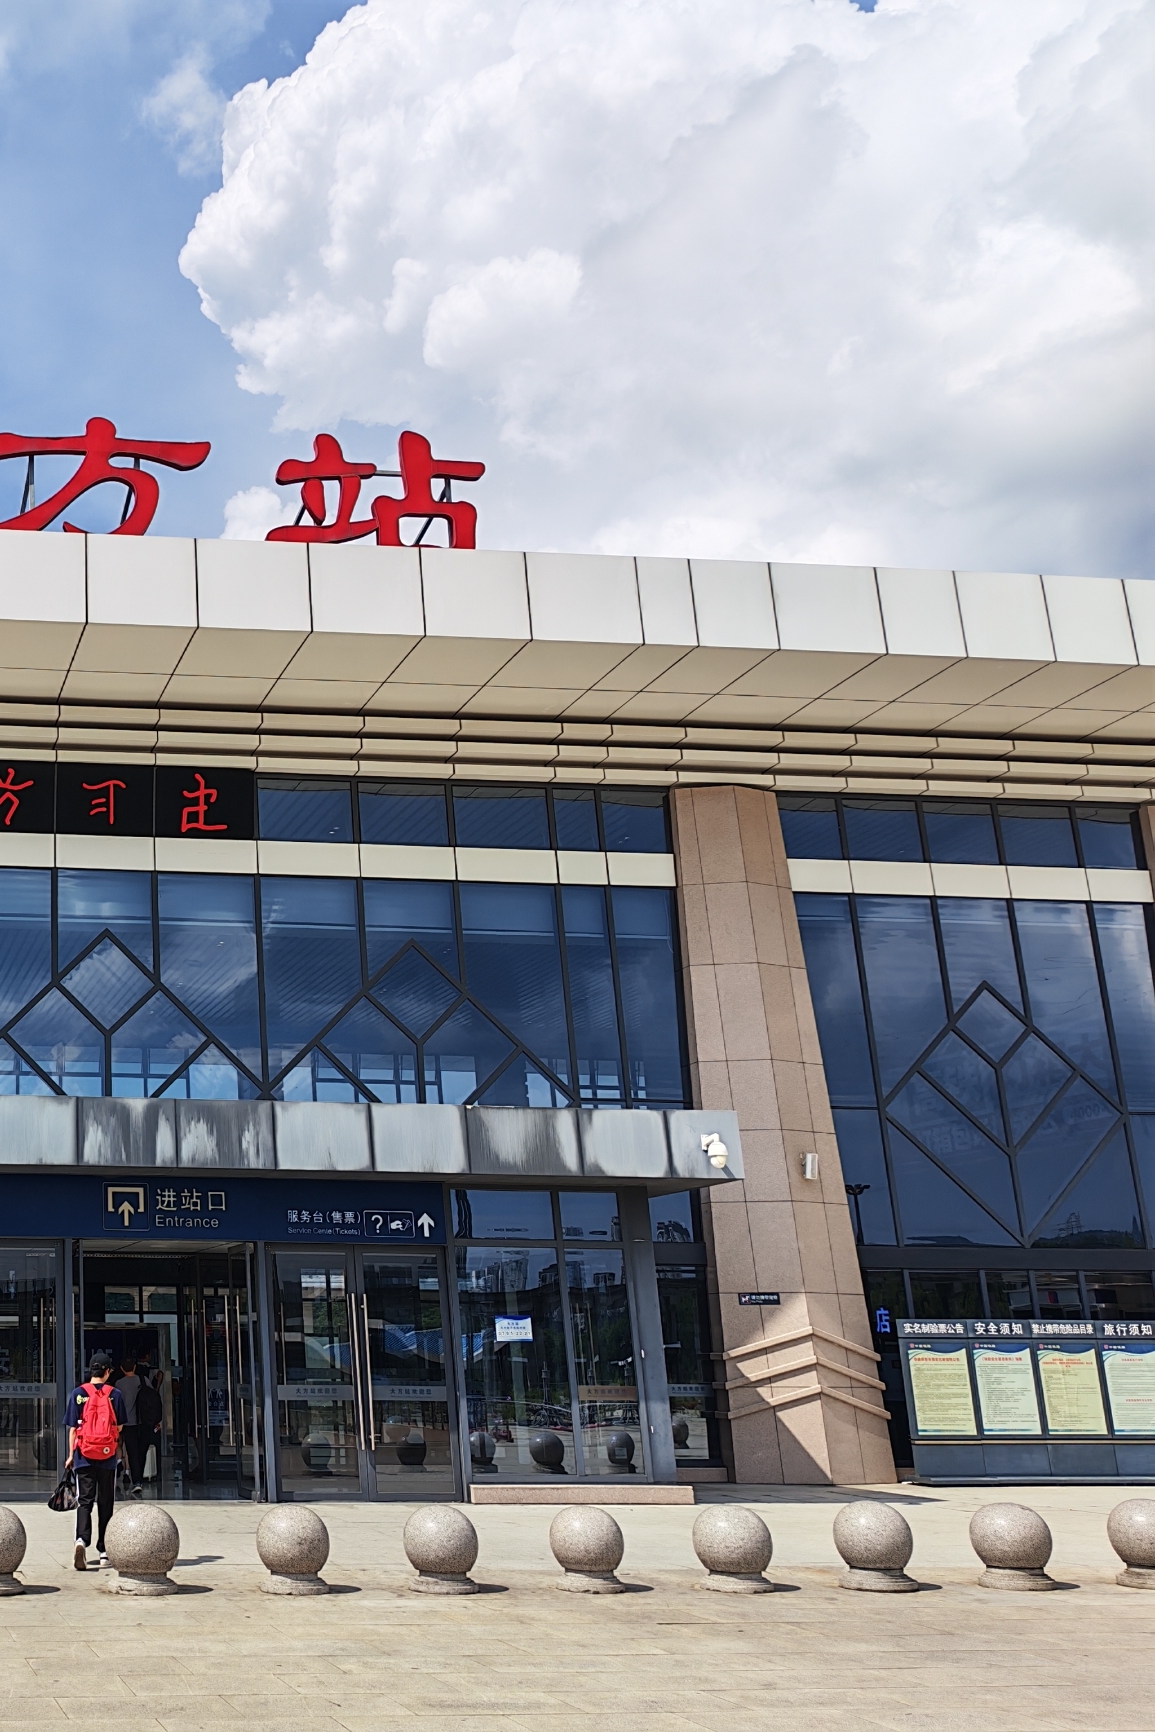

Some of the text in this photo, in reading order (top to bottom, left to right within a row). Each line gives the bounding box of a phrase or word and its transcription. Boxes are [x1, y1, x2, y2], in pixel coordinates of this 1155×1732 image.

[155, 1188, 226, 1211] 进站口
[155, 1214, 219, 1228] Entrance
[875, 1307, 891, 1333] 店
[903, 1322, 965, 1334] 实名制验票公告
[974, 1321, 1024, 1335] 安全须知
[1031, 1323, 1095, 1335] 禁止携带危险品目录
[1103, 1323, 1153, 1336] 旅行须知
